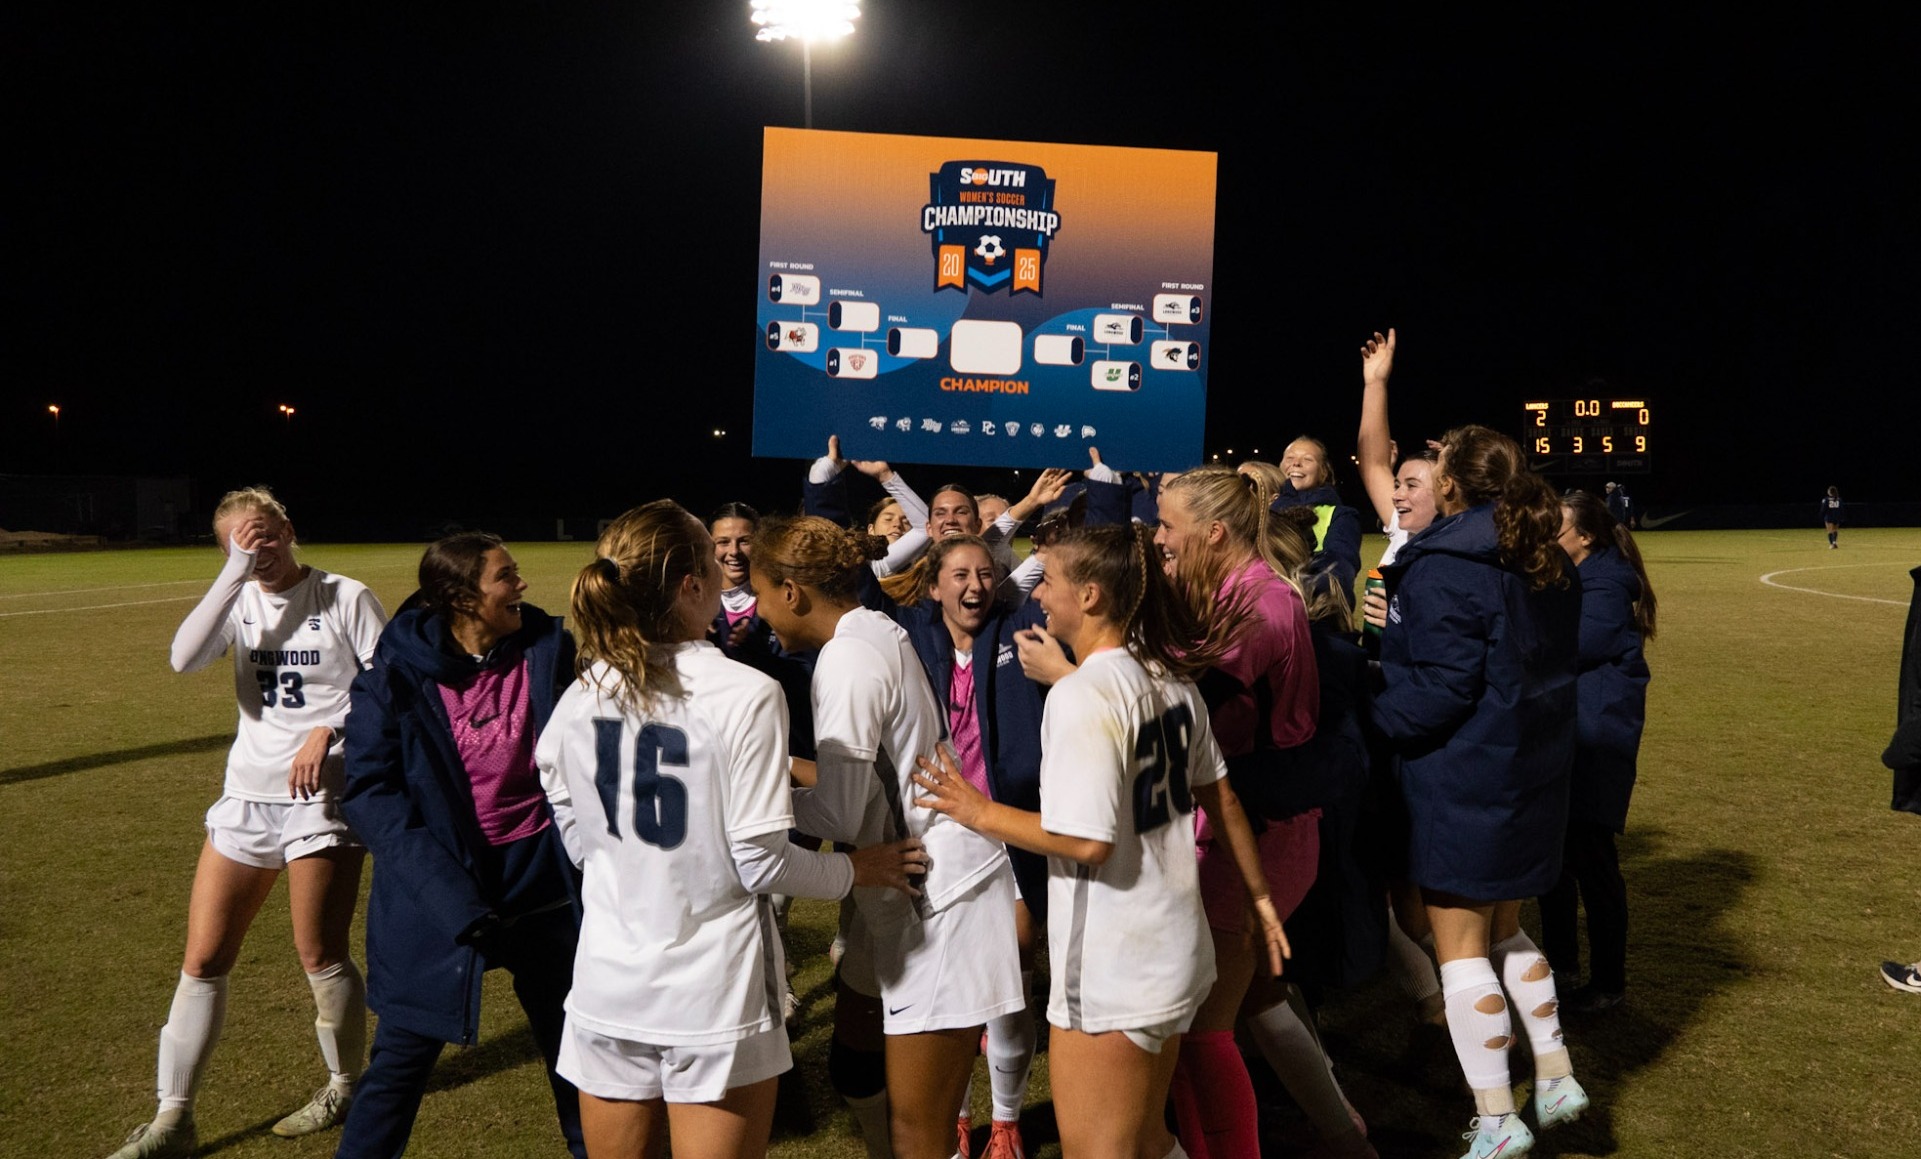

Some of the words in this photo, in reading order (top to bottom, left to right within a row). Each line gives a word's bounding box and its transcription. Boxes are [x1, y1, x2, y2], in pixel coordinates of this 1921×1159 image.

[960, 167, 1026, 187] SOUTH
[960, 191, 994, 203] WOMEN'S
[996, 192, 1026, 206] SOCCER
[924, 205, 1058, 236] CHAMPIONSHIP
[770, 261, 788, 269] FIRST
[790, 262, 814, 270] ROUND
[943, 253, 959, 276] 20
[1019, 257, 1035, 280] 25
[771, 285, 781, 293] #4
[829, 289, 864, 297] SEMIFINAL
[1111, 303, 1145, 311] SEMIFINAL
[1191, 306, 1200, 314] #3
[888, 315, 908, 323] FINAL
[1066, 324, 1086, 332] FINAL
[829, 358, 837, 367] #1
[1130, 373, 1139, 381] #2
[940, 377, 1029, 395] CHAMPION
[1575, 400, 1600, 416] 0.0
[1536, 410, 1546, 426] 2
[1639, 408, 1649, 425] 0
[982, 420, 996, 435] PC
[1536, 437, 1550, 454] 15
[1573, 436, 1583, 453] 3
[1602, 436, 1613, 453] 5
[1635, 436, 1646, 452] 9
[249, 650, 320, 666] ONGWOOD
[256, 670, 305, 709] 33
[592, 716, 690, 851] 16
